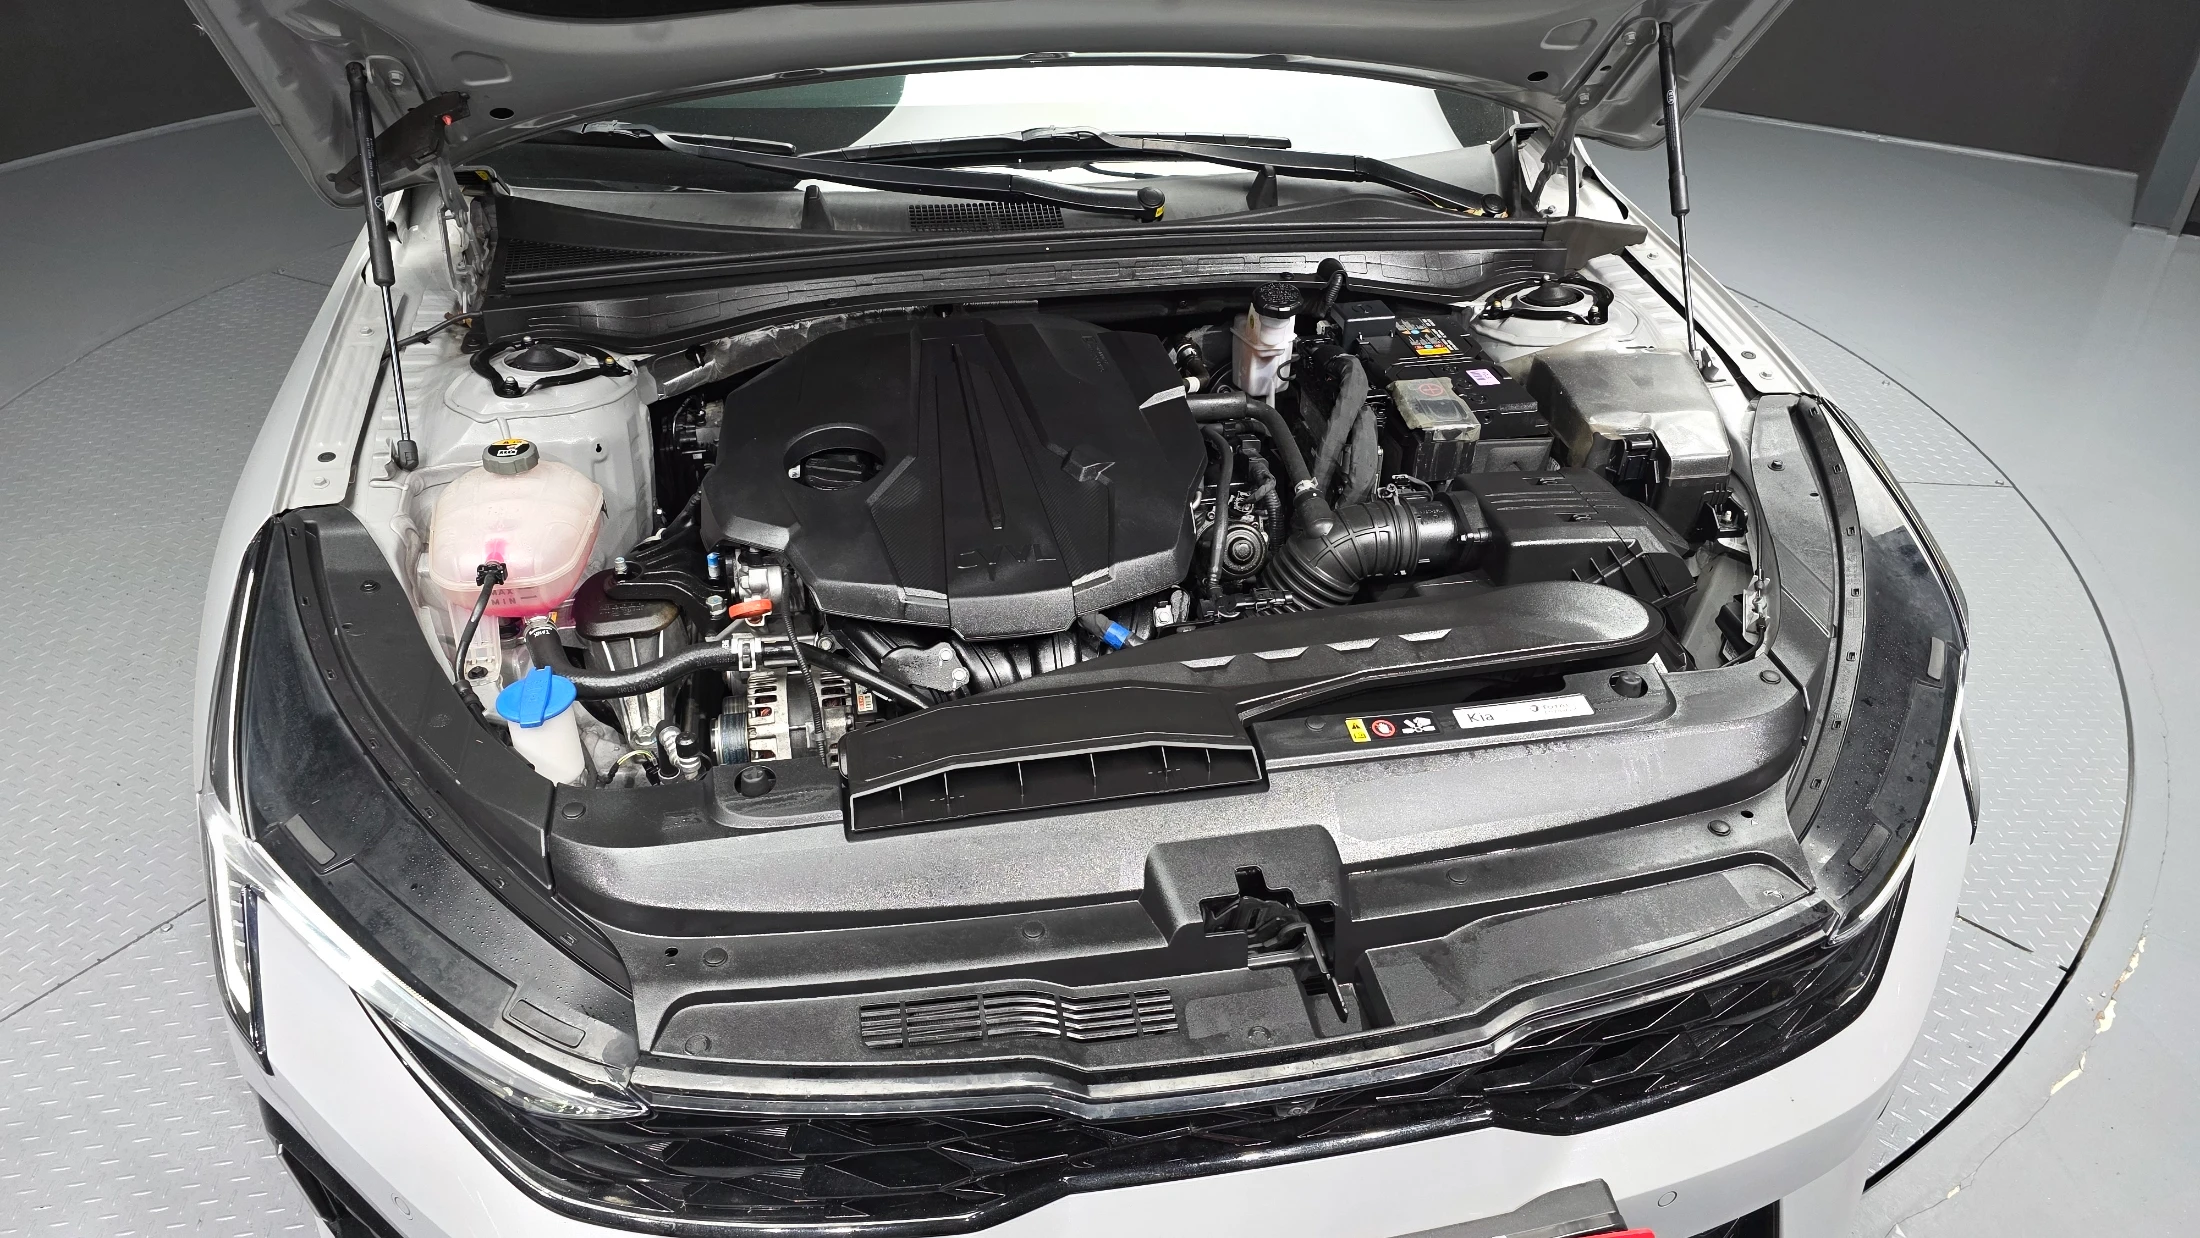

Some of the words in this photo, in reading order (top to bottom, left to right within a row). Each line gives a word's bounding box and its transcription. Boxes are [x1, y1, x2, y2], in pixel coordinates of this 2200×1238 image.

[491, 588, 514, 596] MAX
[491, 597, 517, 606] MIN
[1467, 712, 1495, 723] Kia
